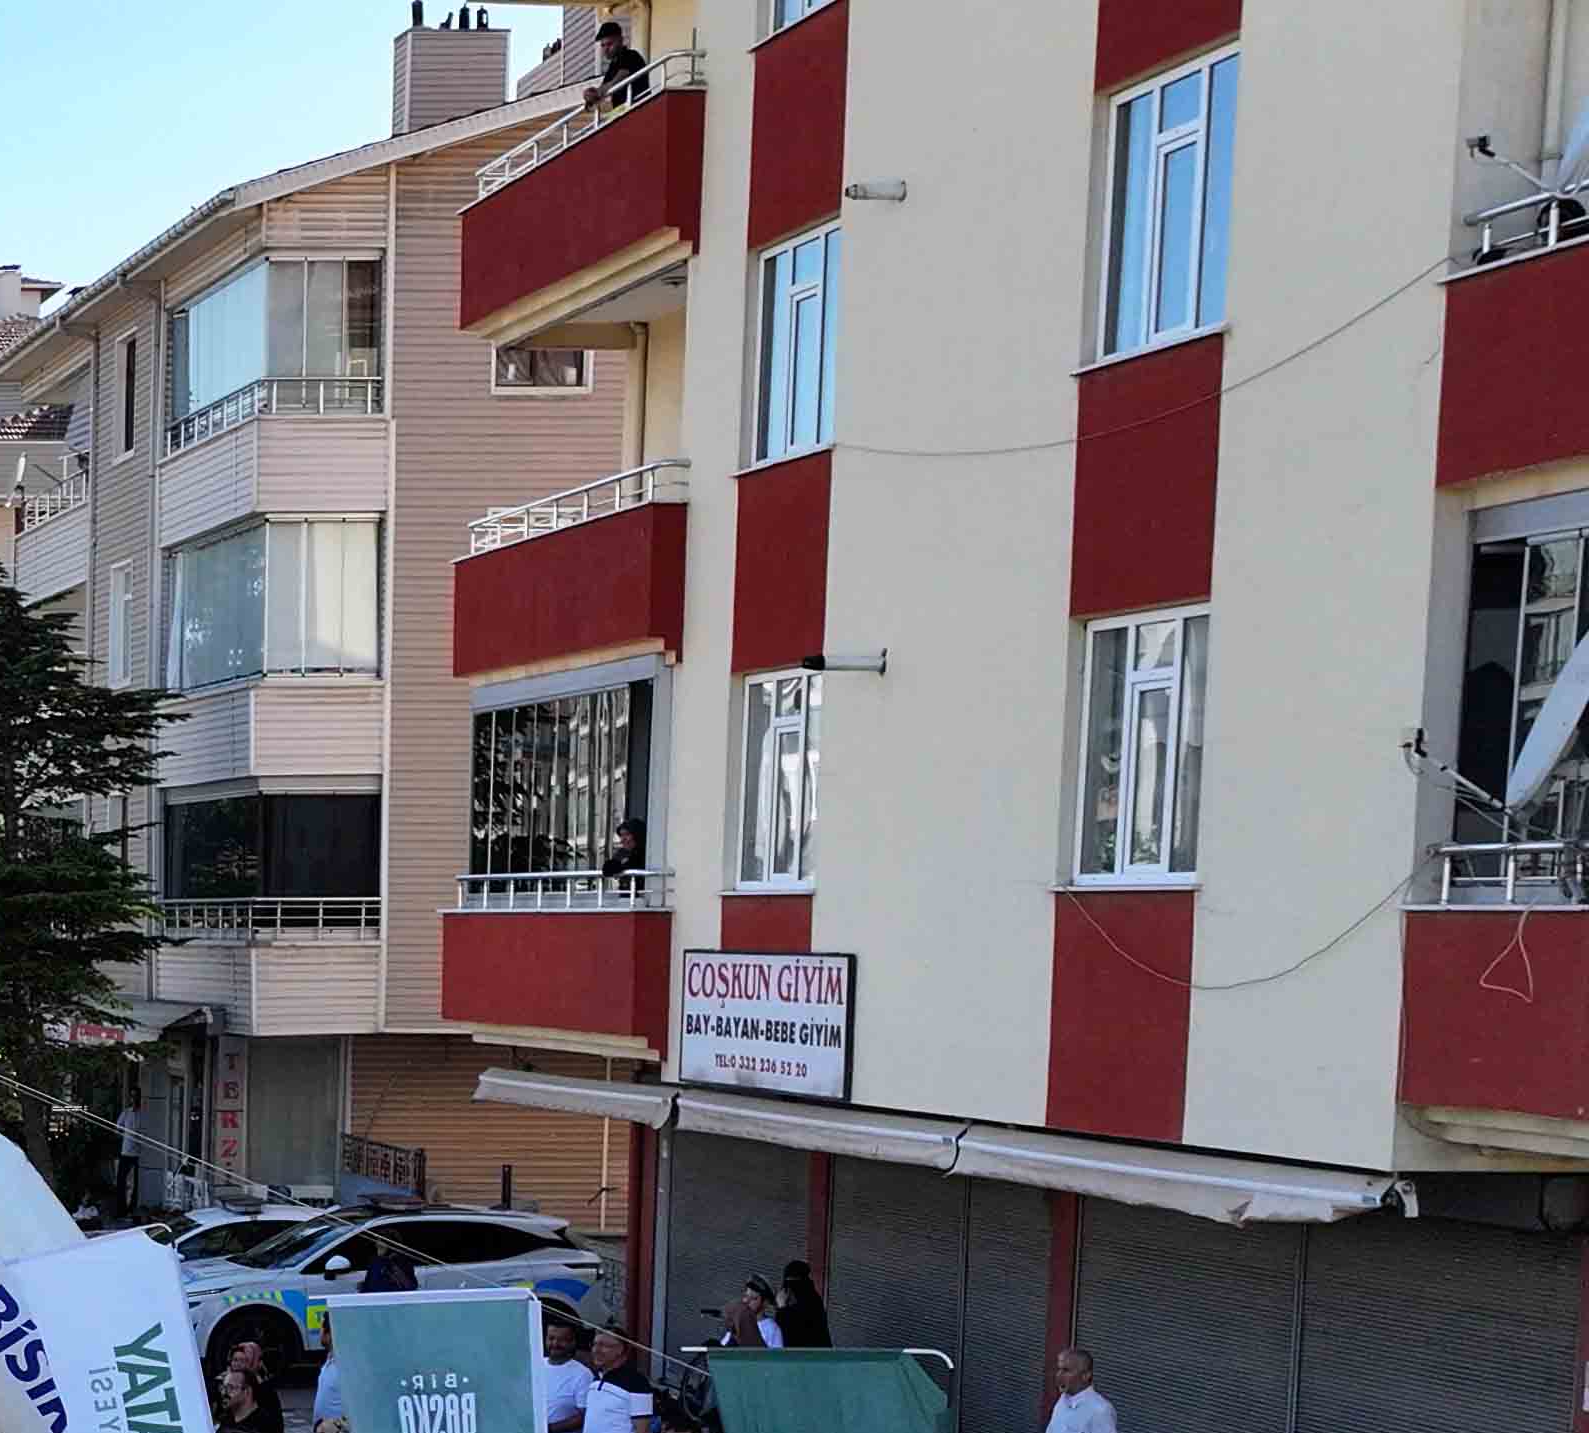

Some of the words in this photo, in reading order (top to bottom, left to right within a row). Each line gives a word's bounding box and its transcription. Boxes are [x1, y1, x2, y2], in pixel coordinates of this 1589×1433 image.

[687, 962, 771, 1008] COŞKUN
[777, 958, 844, 1006] GİYİM
[685, 1013, 797, 1045] BAY-BAYAN-BEBE
[799, 1018, 842, 1049] GİYİM
